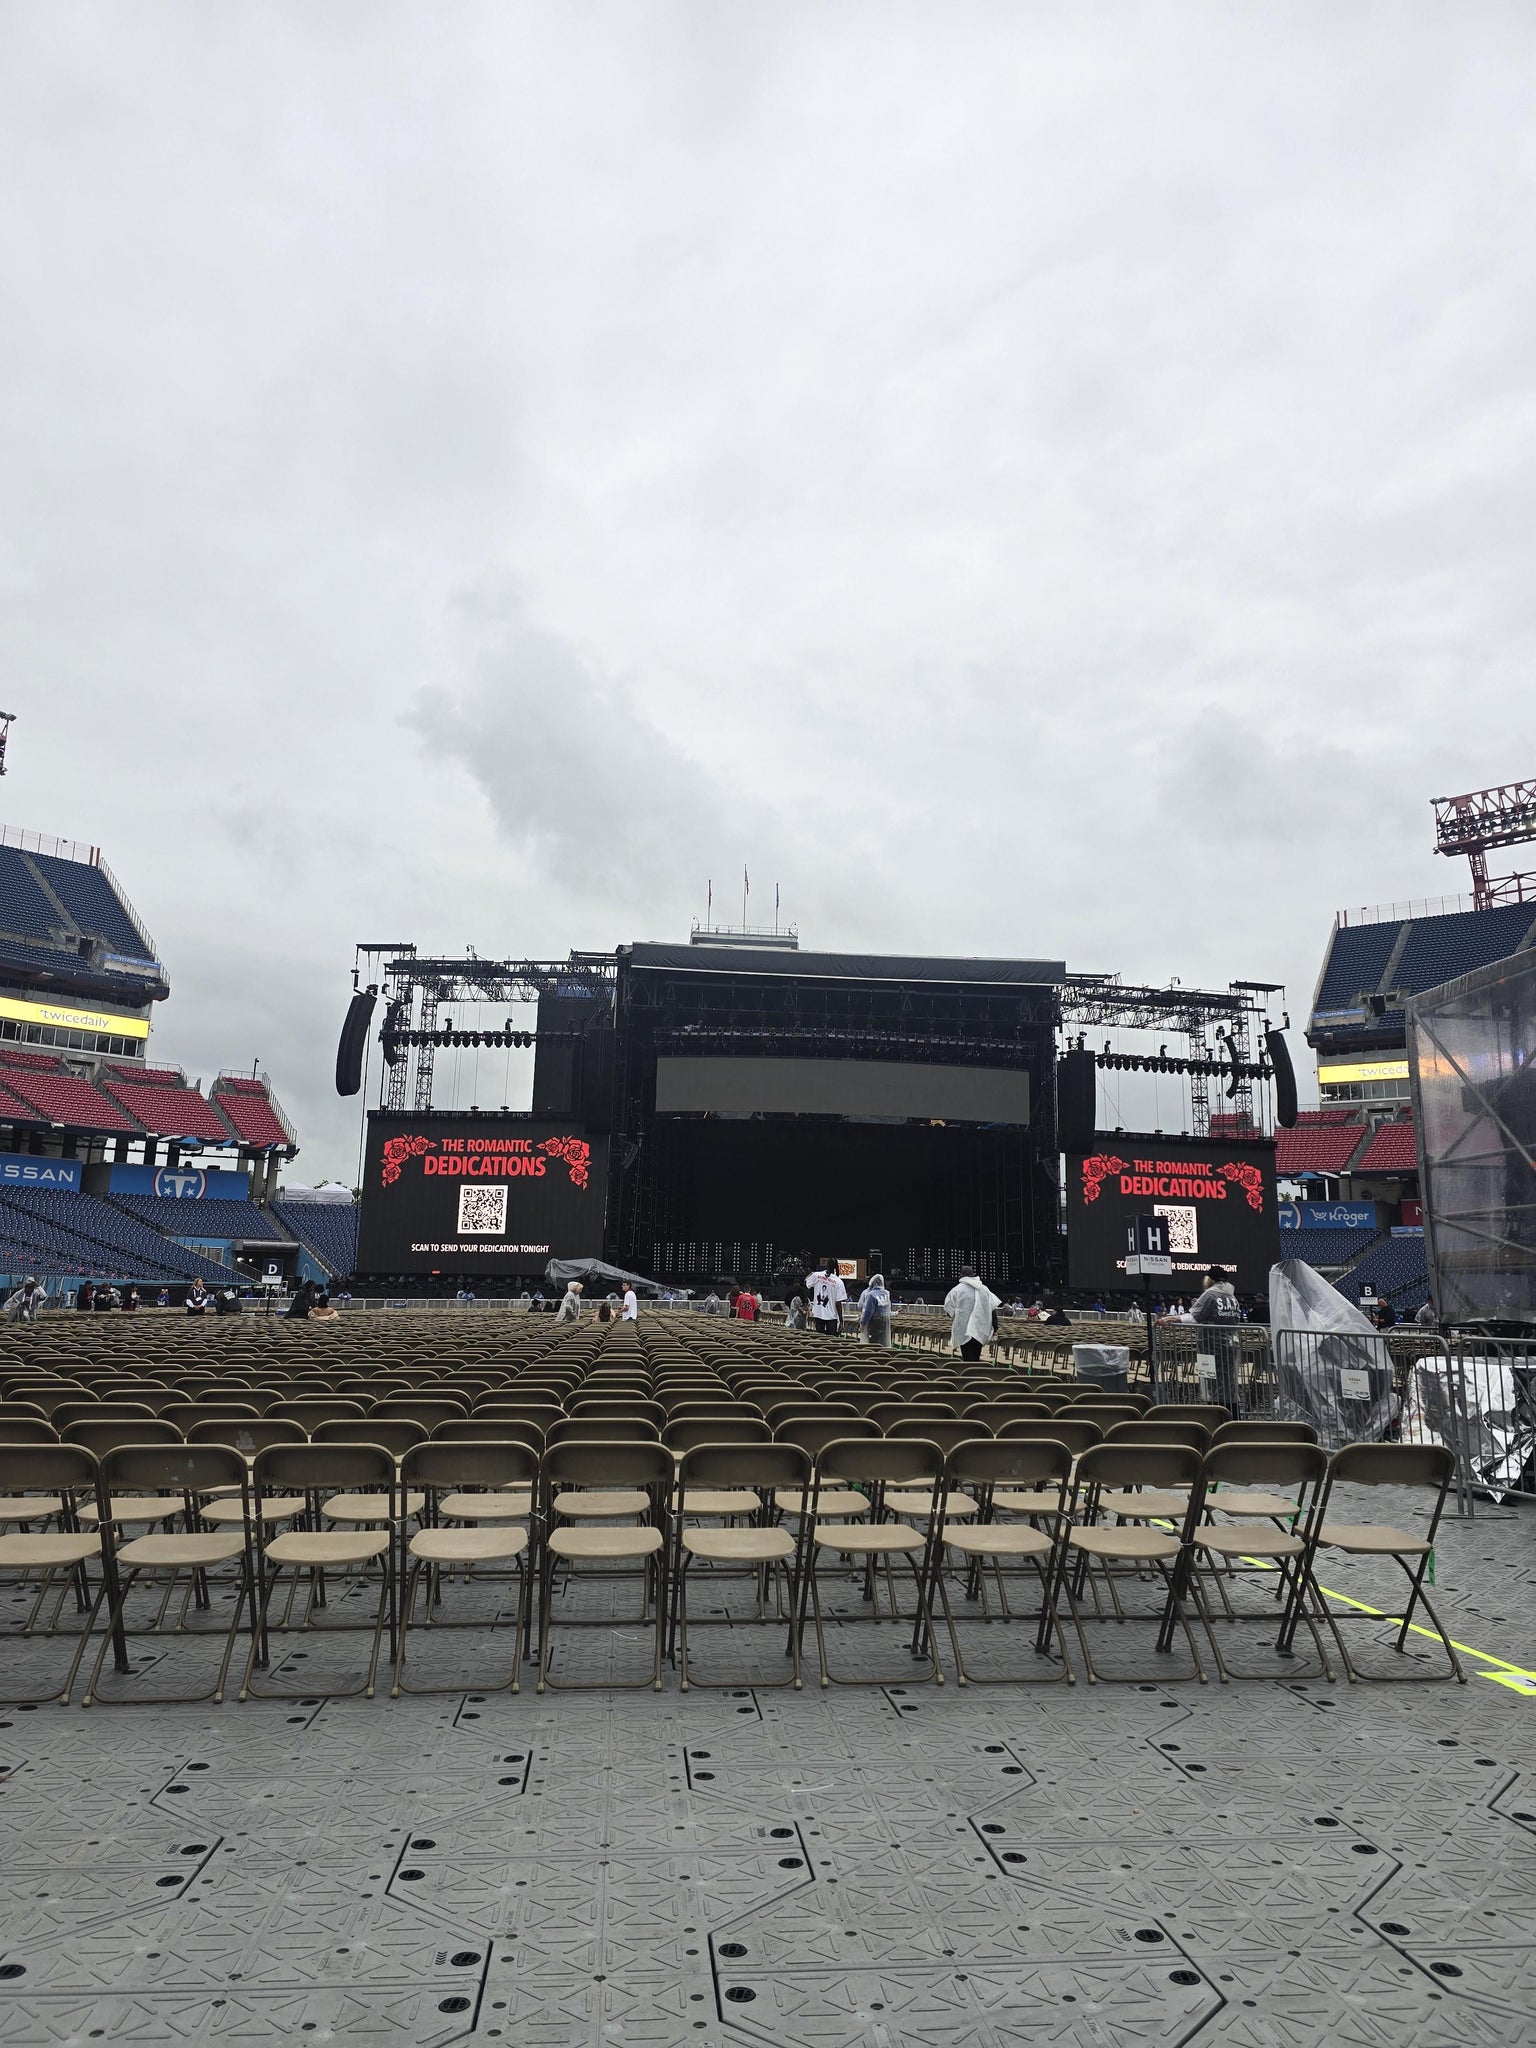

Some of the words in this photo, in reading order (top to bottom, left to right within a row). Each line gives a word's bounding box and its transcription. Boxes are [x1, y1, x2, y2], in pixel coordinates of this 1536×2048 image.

[442, 1139, 464, 1152] THE
[467, 1139, 532, 1153] ROMANTIC
[0, 1164, 74, 1183] SSAN
[424, 1156, 546, 1177] DEDICATIONS
[1133, 1159, 1153, 1174] THE
[1156, 1161, 1213, 1176] ROMANTIC
[1120, 1175, 1227, 1200] DEDICATIONS
[1329, 1206, 1370, 1227] Kroger
[1127, 1227, 1135, 1252] H
[1147, 1226, 1162, 1251] H
[411, 1243, 429, 1252] SCAN
[430, 1243, 440, 1252] TO
[440, 1244, 459, 1252] SEND
[459, 1244, 479, 1252] YOUR
[479, 1244, 519, 1253] DEDICATION
[520, 1245, 550, 1253] TONIGHT
[268, 1264, 278, 1275] D
[1176, 1262, 1212, 1272] DEDICATION
[1364, 1286, 1372, 1296] B
